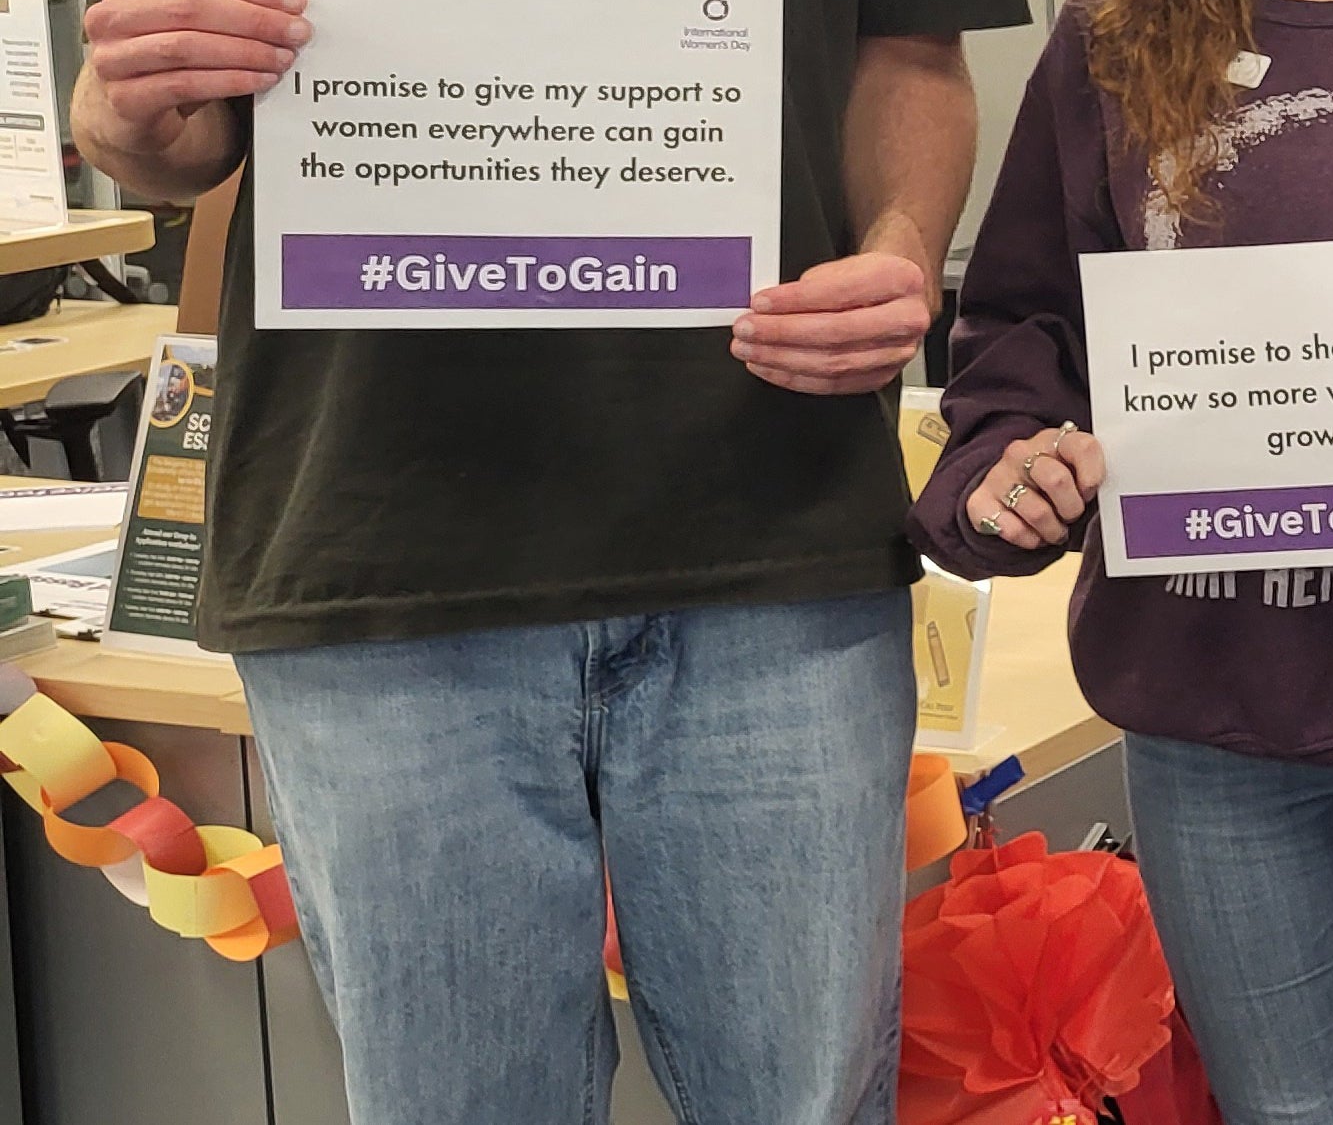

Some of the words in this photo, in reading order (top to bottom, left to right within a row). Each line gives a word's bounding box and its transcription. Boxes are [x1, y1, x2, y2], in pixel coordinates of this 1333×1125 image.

[295, 71, 300, 94] I
[313, 74, 428, 103] promise
[438, 78, 464, 98] to
[475, 76, 534, 106] give
[545, 85, 588, 108] my
[597, 83, 703, 109] support
[712, 87, 740, 102] so
[312, 121, 417, 139] women
[429, 115, 595, 147] everywhere
[605, 126, 652, 141] can
[664, 119, 723, 149] gain
[301, 152, 345, 178] the
[355, 157, 540, 186] opportunities
[551, 156, 611, 189] they
[620, 157, 734, 182] deserve.
[361, 254, 676, 291] #GiveToGain
[1132, 344, 1138, 367] I
[1149, 340, 1255, 375] promise
[1265, 341, 1291, 362] to
[1124, 385, 1198, 412] know
[1209, 392, 1237, 408] so
[1248, 387, 1317, 406] more
